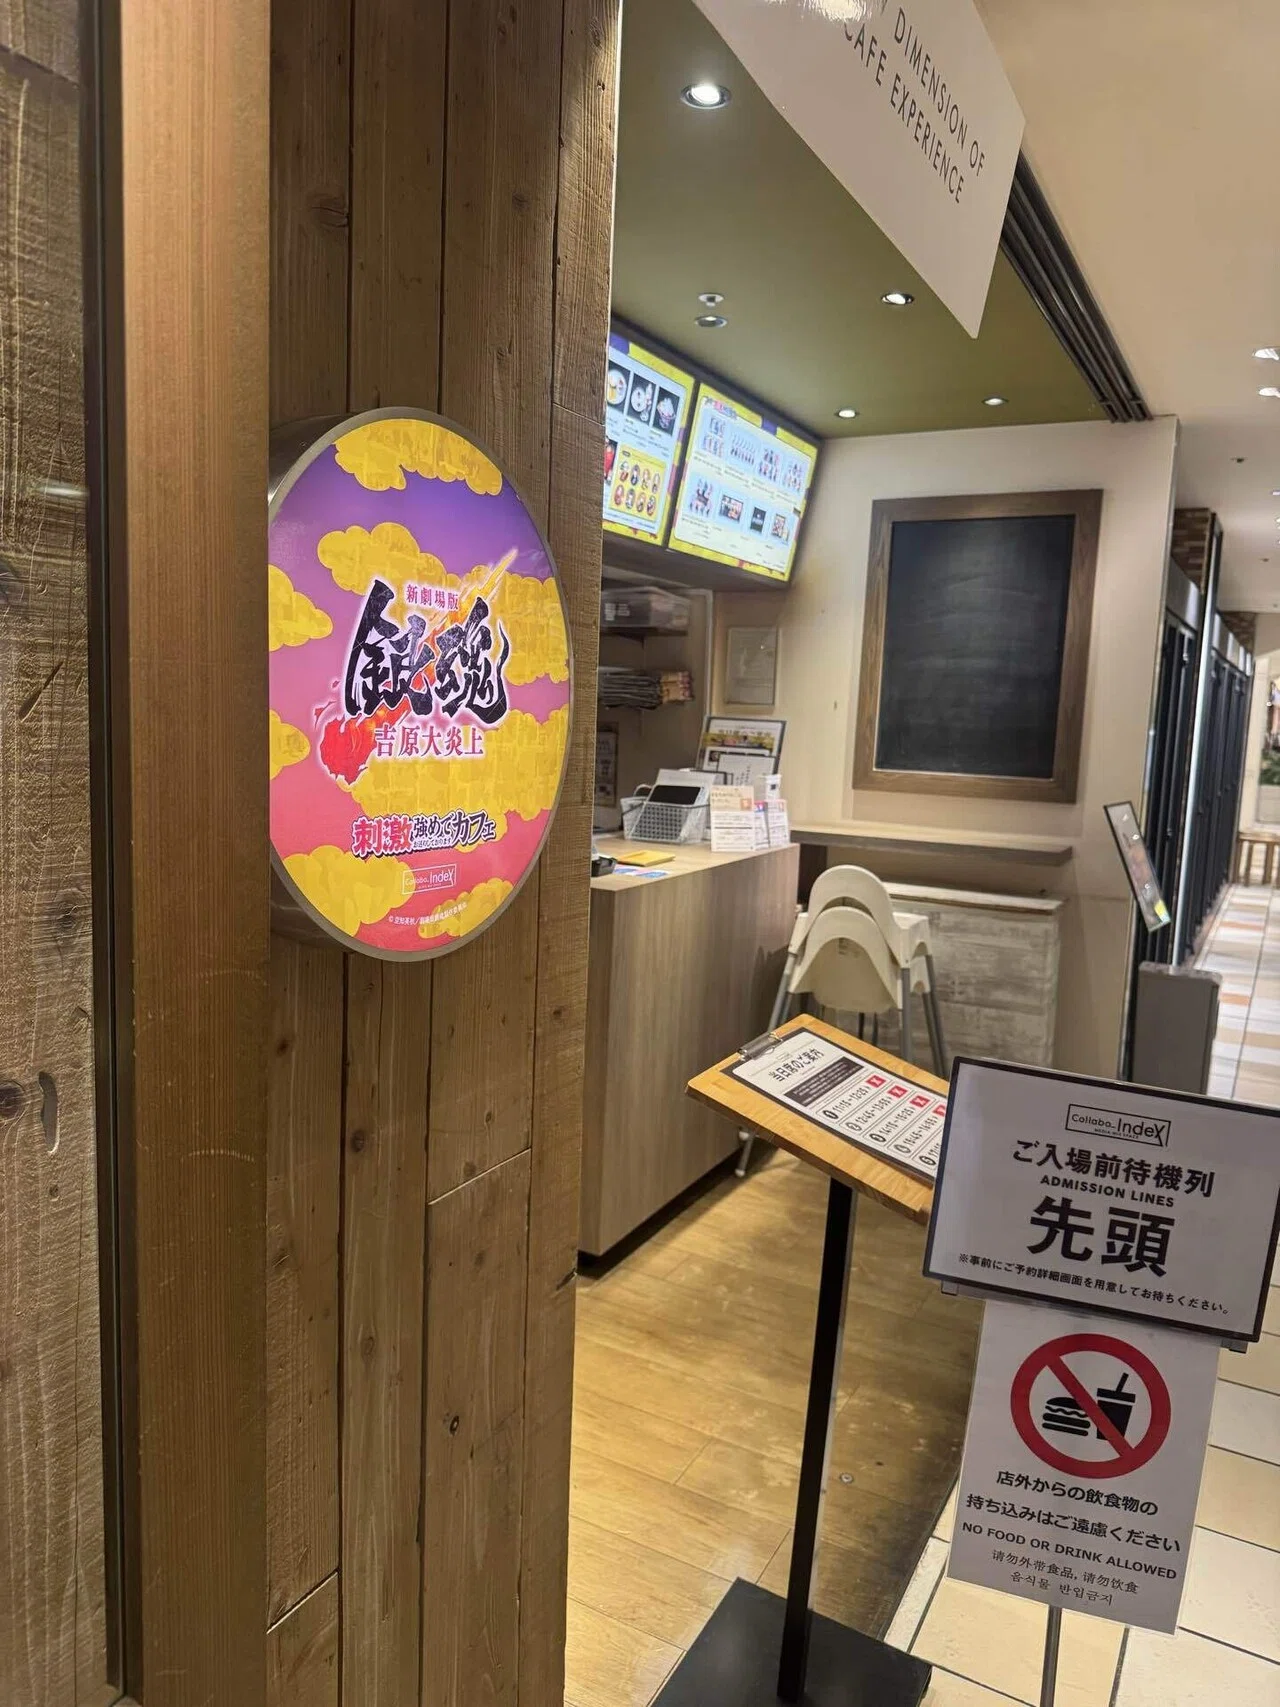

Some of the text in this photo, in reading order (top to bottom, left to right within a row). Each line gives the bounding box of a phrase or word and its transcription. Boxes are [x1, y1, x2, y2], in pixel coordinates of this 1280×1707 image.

[894, 7, 985, 176] DIMENSION OF
[890, 73, 964, 203] EXPERIENCE
[406, 584, 459, 610] 新劇場版
[345, 580, 509, 724] 銀魂
[375, 725, 484, 757] 吉原大炎上
[1013, 1139, 1215, 1197] ご入場前待機列
[1040, 1175, 1174, 1208] ADMISSION LINES
[1027, 1195, 1175, 1277] 先頭
[996, 1471, 1158, 1516] 店外からの飲食物の
[962, 1521, 1177, 1580] NO FOOD OR DRINK ALLOWED
[966, 1494, 1181, 1552] 持ち込みはご遠慮ください
[1011, 1571, 1113, 1606] 음식물 반입금지
